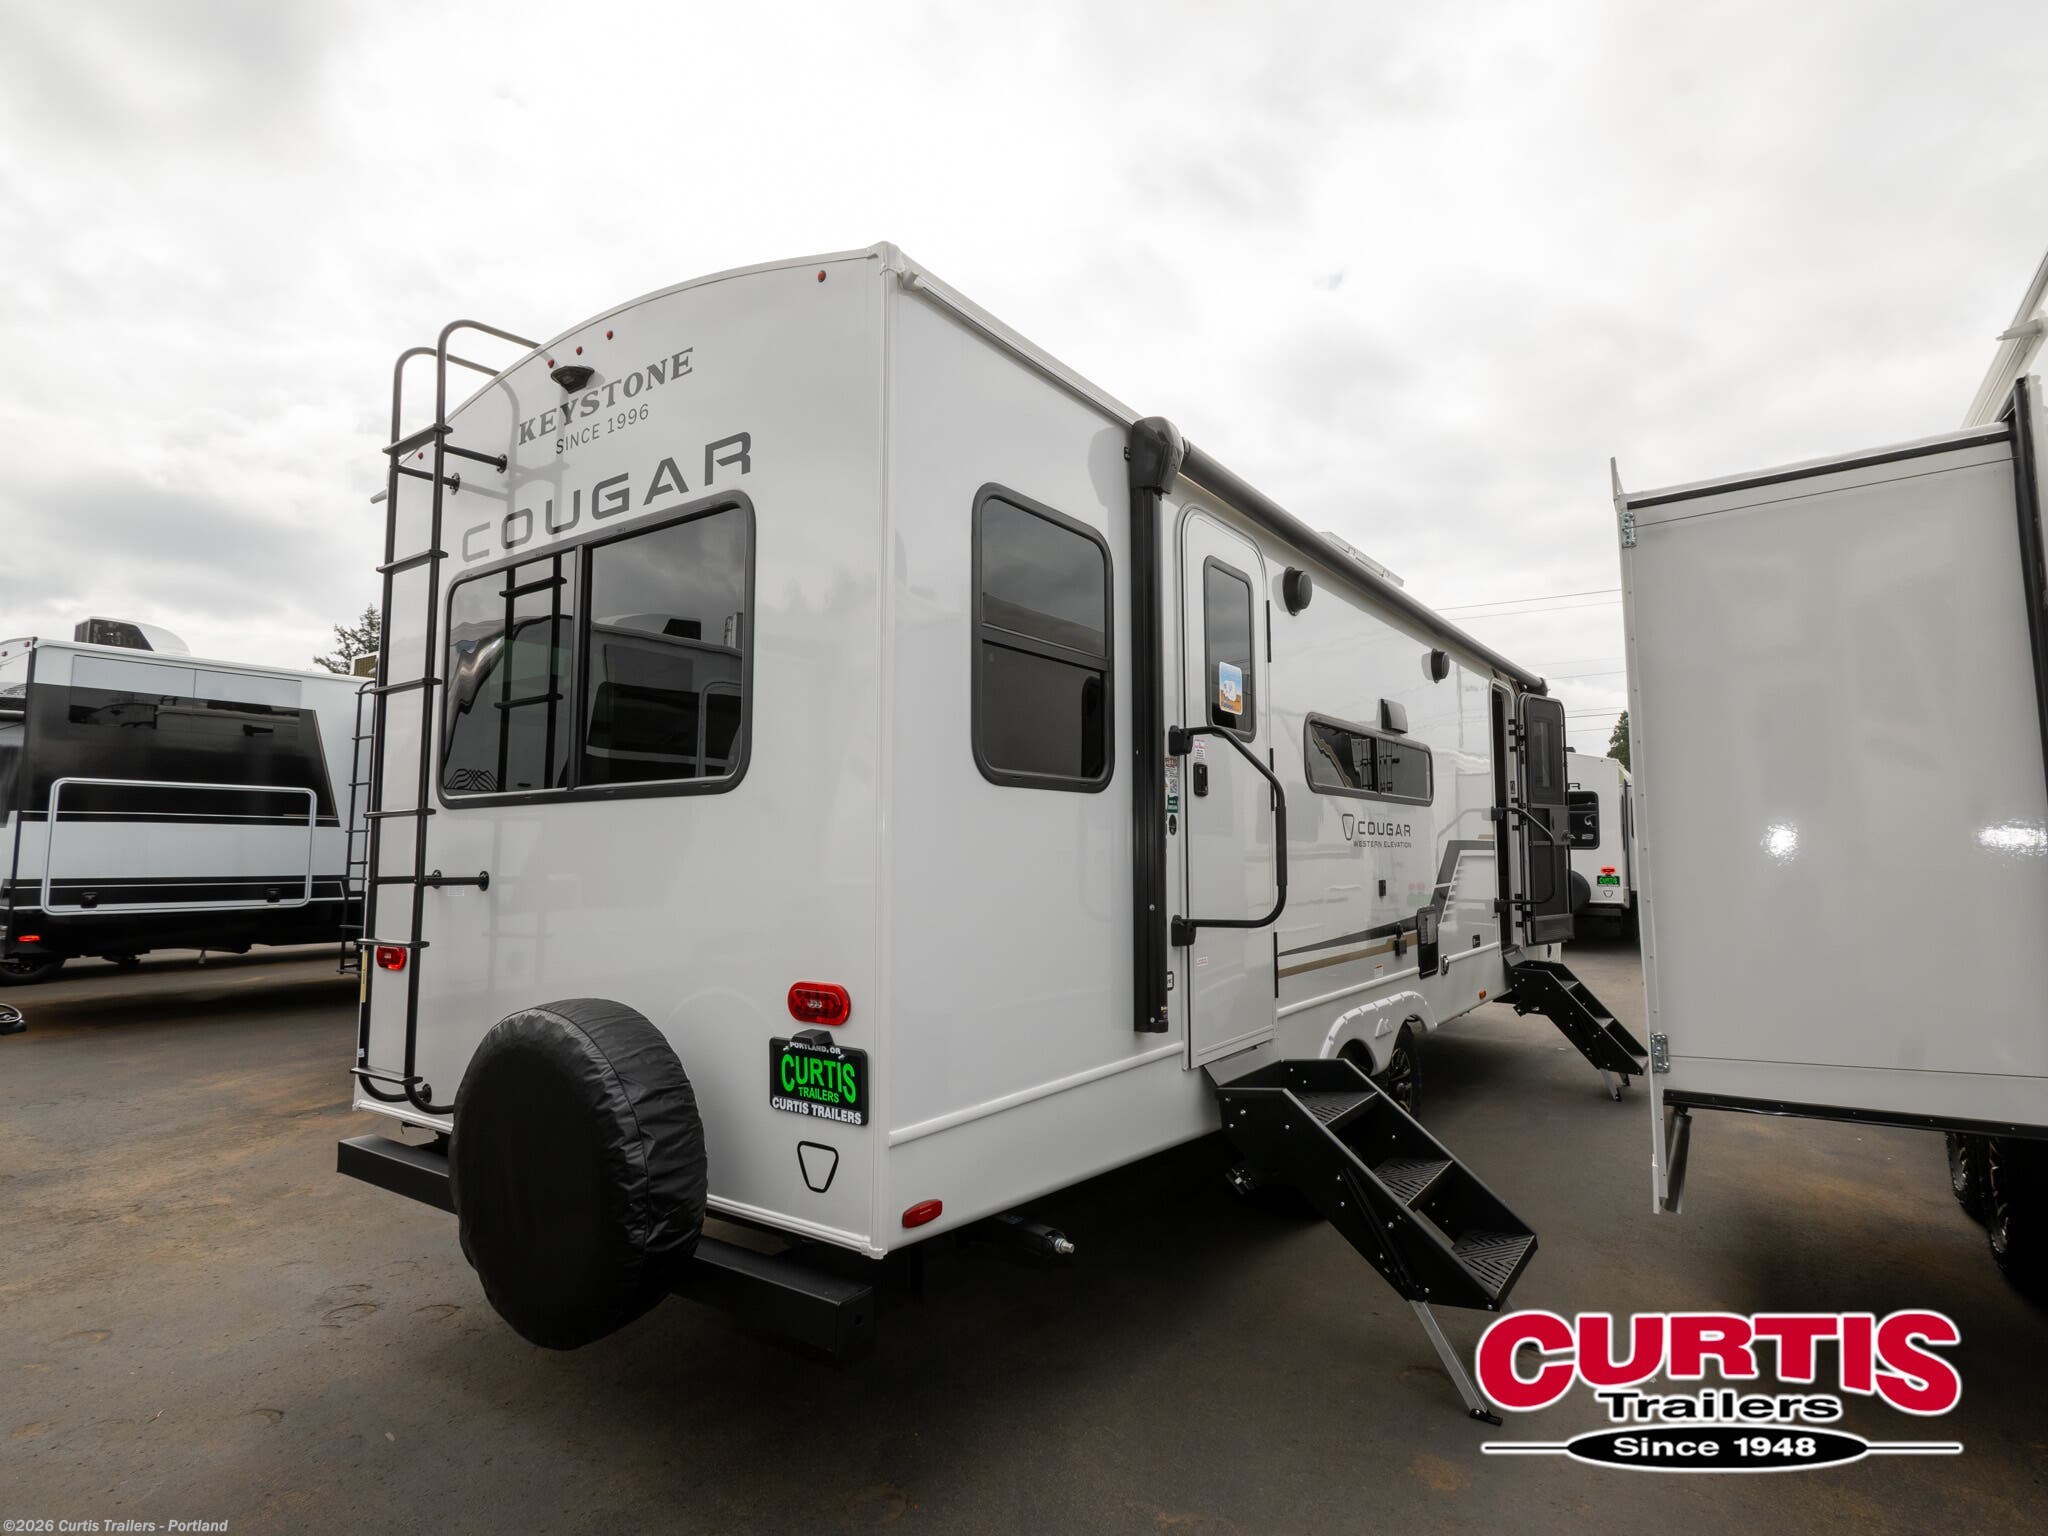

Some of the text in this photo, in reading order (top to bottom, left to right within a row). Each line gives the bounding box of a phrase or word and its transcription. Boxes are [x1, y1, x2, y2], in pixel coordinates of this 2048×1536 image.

[518, 347, 694, 446] KEYSTONE
[555, 403, 650, 454] SINCE 1996
[461, 431, 752, 563] COUGAR
[1357, 820, 1411, 837] COUGAR
[1353, 840, 1412, 849] WESTERN ELEVATION
[829, 1046, 841, 1055] OR
[781, 1053, 857, 1104] CURTIS
[798, 1086, 840, 1103] TRAILERS
[772, 1096, 862, 1125] CURTIS TRAILERS
